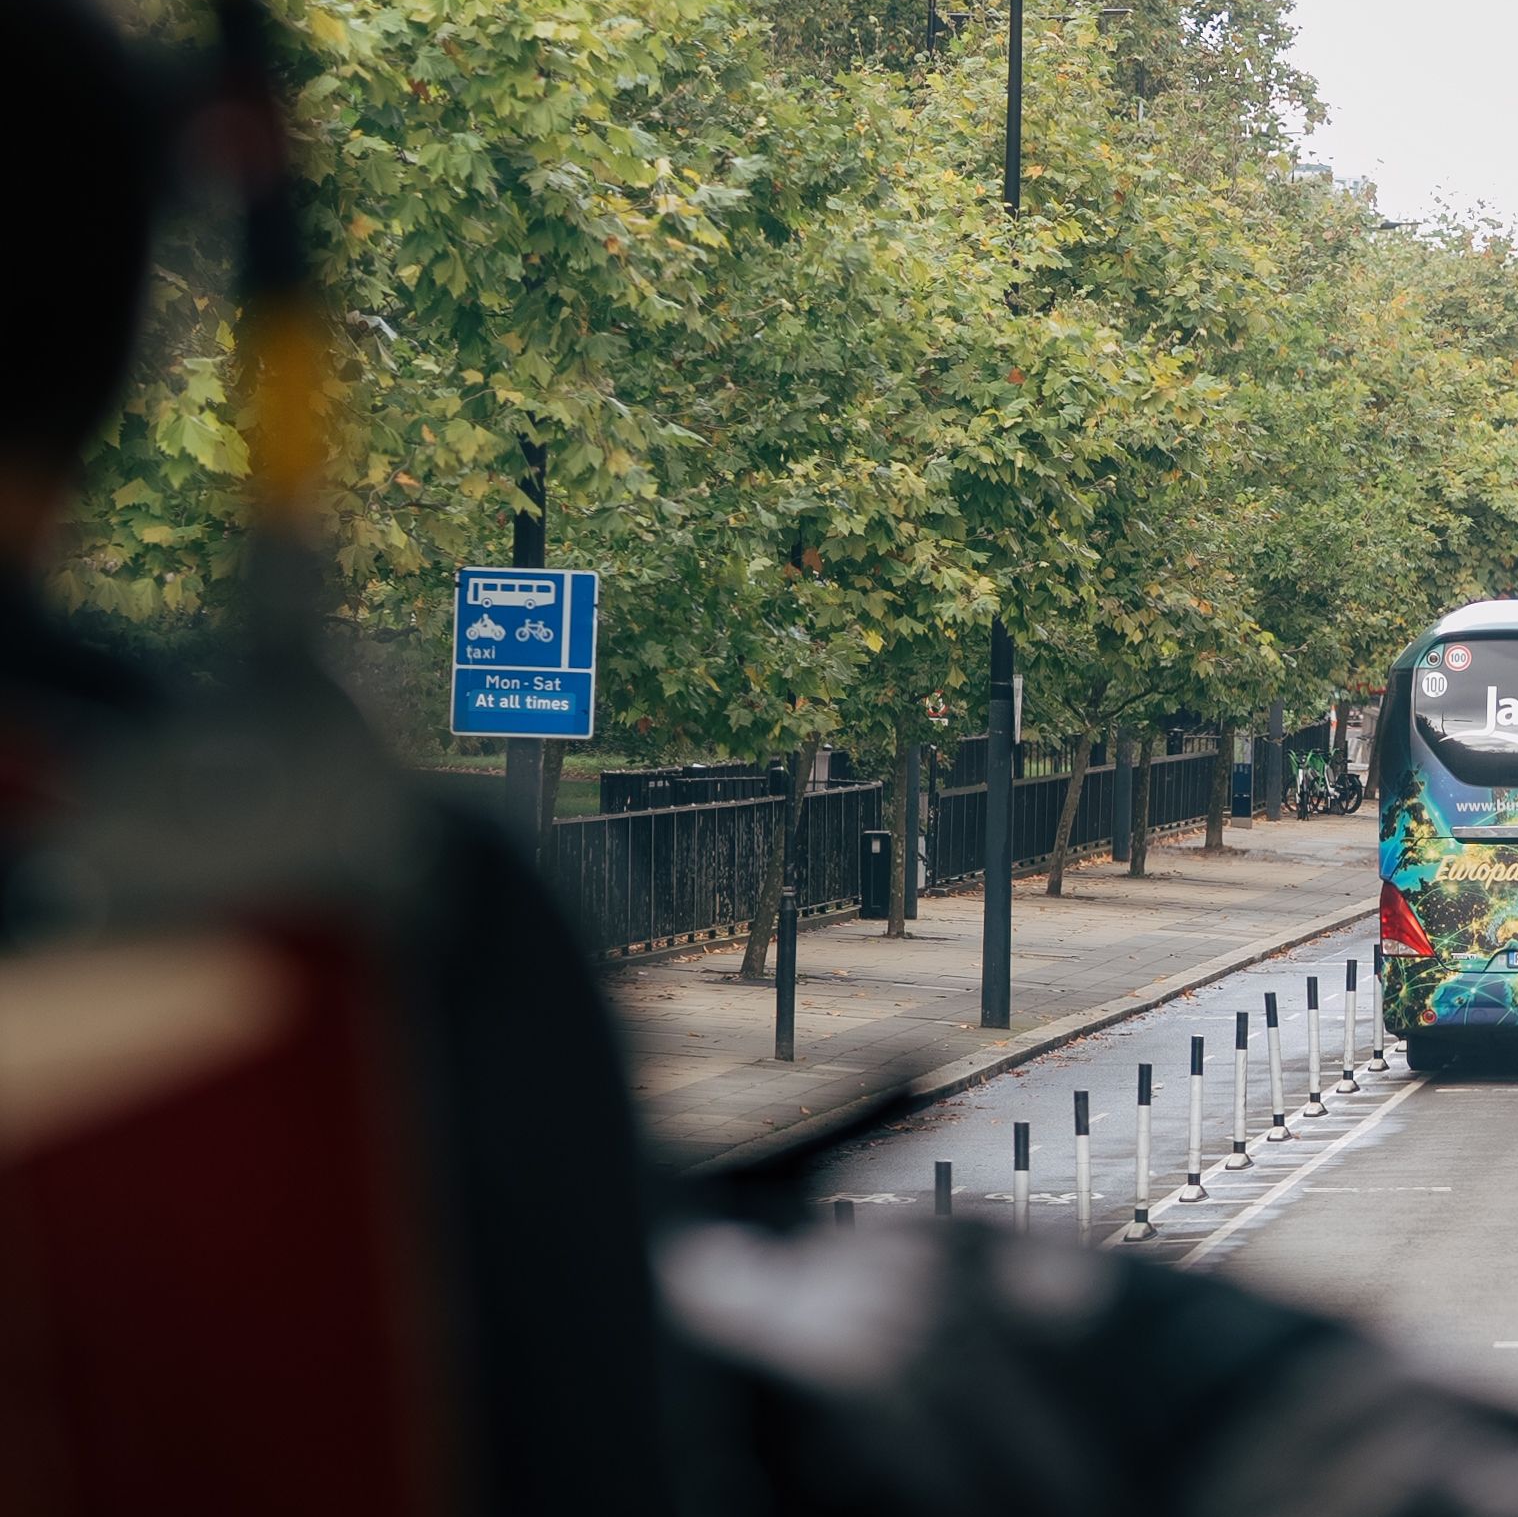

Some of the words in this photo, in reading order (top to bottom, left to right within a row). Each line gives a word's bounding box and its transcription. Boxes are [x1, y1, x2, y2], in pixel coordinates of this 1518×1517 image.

[466, 645, 496, 659] taxi
[1451, 653, 1467, 663] 100
[486, 675, 520, 689] Mon
[533, 676, 561, 691] Sat
[1426, 676, 1445, 693] 100
[475, 694, 494, 708] At
[499, 695, 520, 708] all
[525, 696, 569, 710] times
